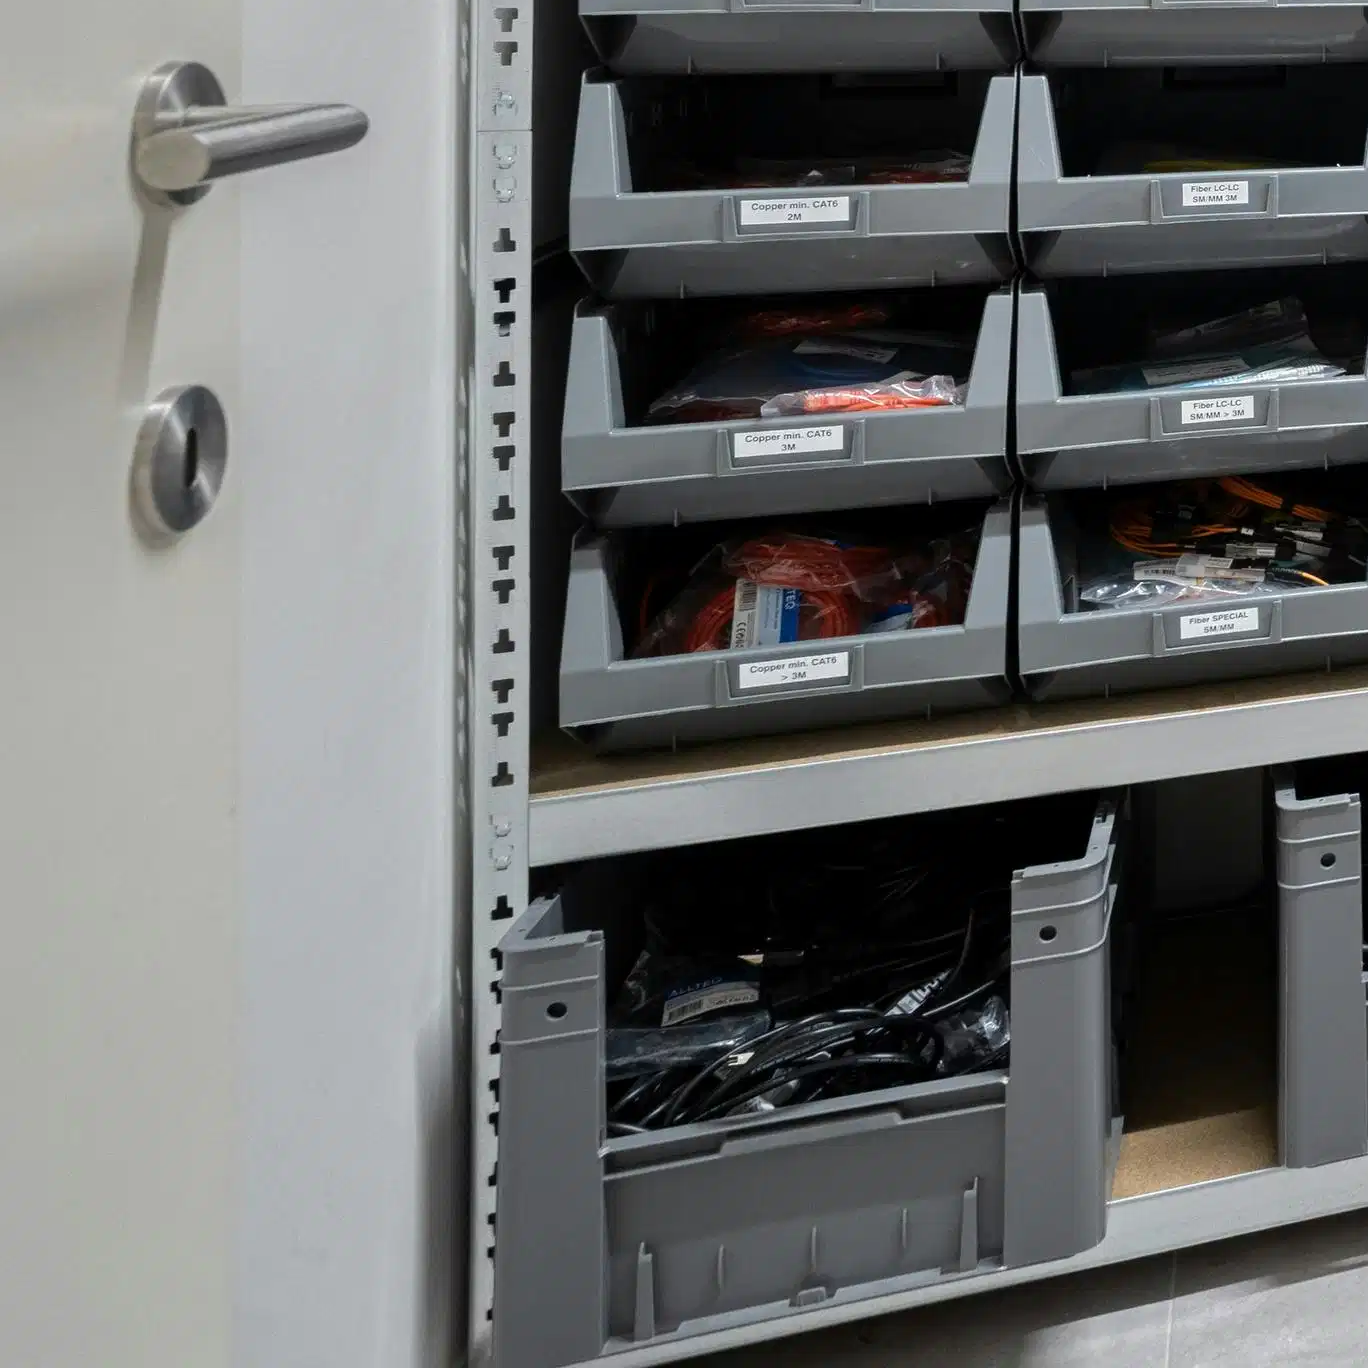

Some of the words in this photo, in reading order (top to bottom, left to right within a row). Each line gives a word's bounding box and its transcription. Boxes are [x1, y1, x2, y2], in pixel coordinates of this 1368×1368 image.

[1191, 185, 1212, 193] Fiber
[1214, 184, 1240, 192] LC-LC
[1225, 194, 1237, 202] 3M
[751, 203, 787, 212] Copper
[812, 200, 839, 209] CAT6
[787, 213, 802, 221] 2M
[1216, 400, 1242, 408] LC-LC
[1232, 409, 1245, 417] 3M
[745, 435, 781, 444] Copper
[783, 432, 804, 440] min.
[806, 429, 832, 438] CAT6
[781, 443, 796, 451] 3M
[784, 590, 796, 610] TEQ
[1189, 617, 1210, 625] Fiber
[1212, 612, 1249, 622] SPECIAL
[750, 664, 786, 674] Copper
[788, 661, 809, 669] min.
[811, 656, 837, 666] CAT6
[792, 671, 807, 680] 3M
